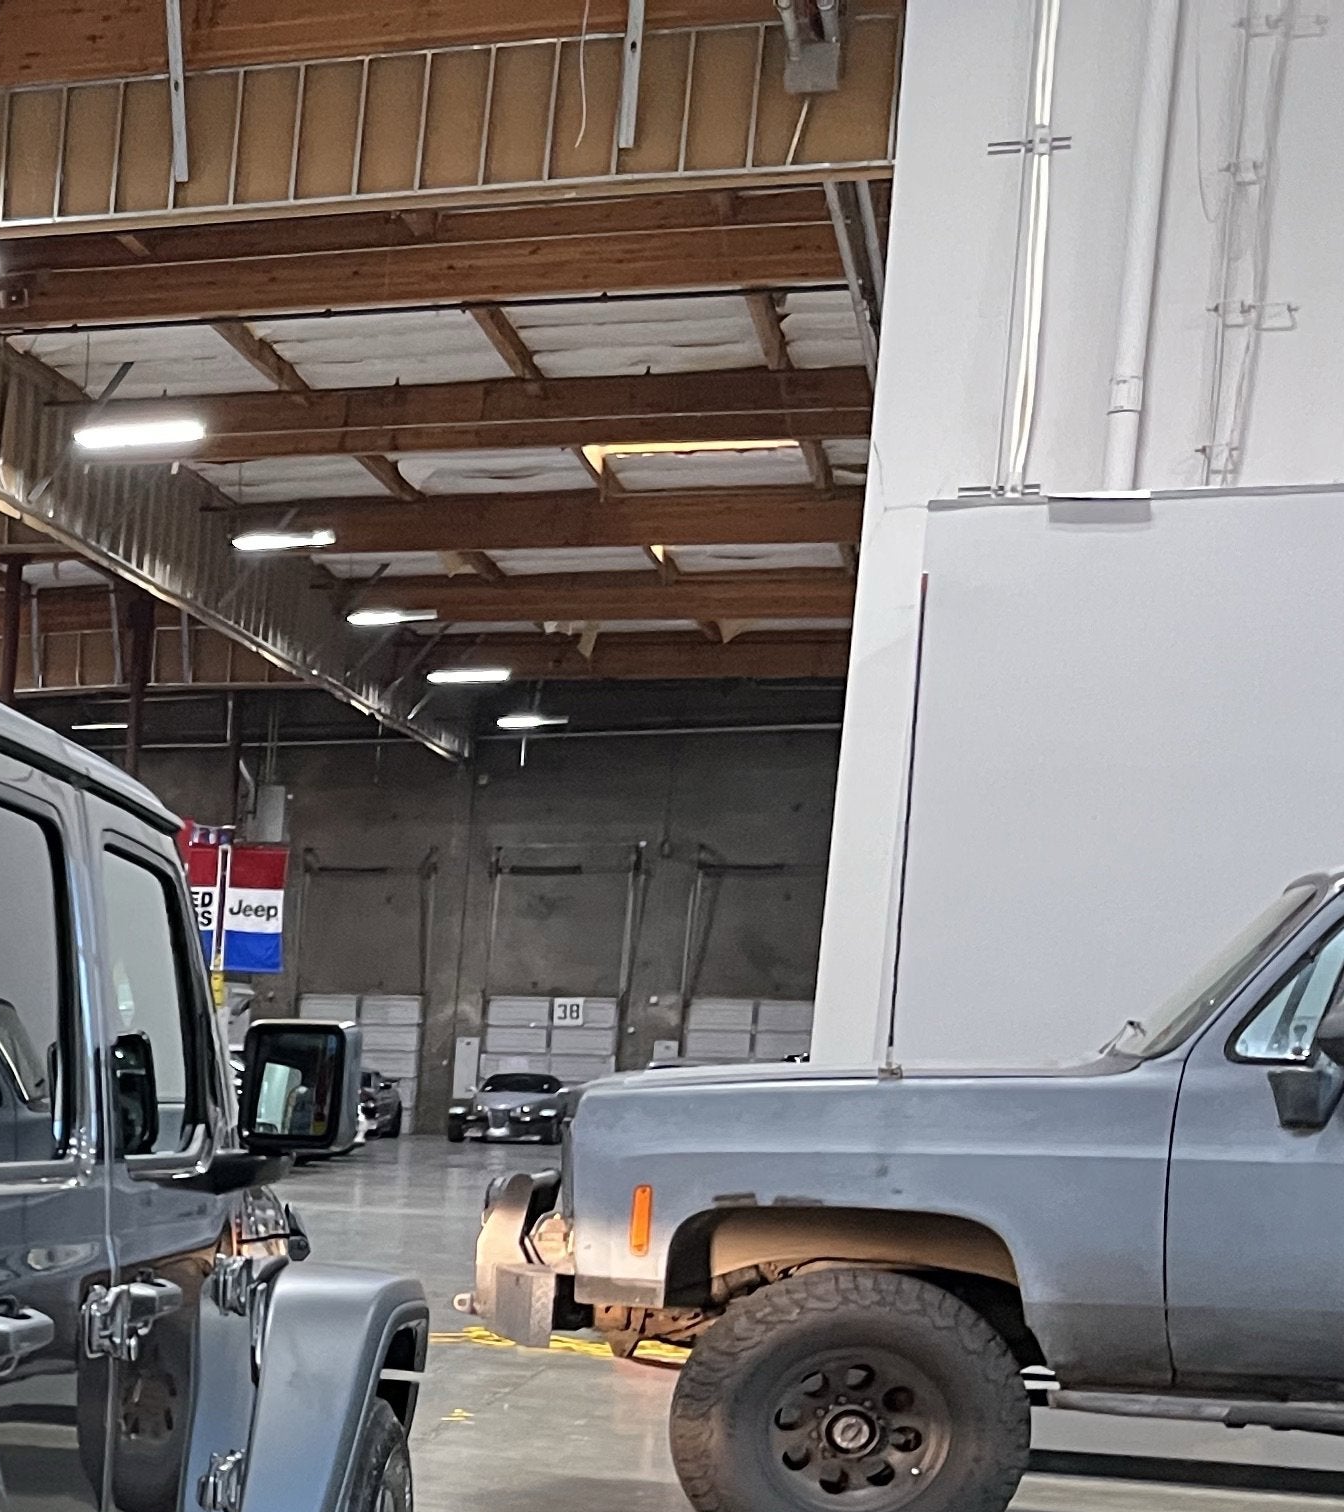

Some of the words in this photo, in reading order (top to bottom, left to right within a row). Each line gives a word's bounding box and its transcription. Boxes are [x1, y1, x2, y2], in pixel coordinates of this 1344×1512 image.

[191, 891, 214, 908] ED
[229, 899, 279, 921] Jeep
[556, 1003, 581, 1021] 38
